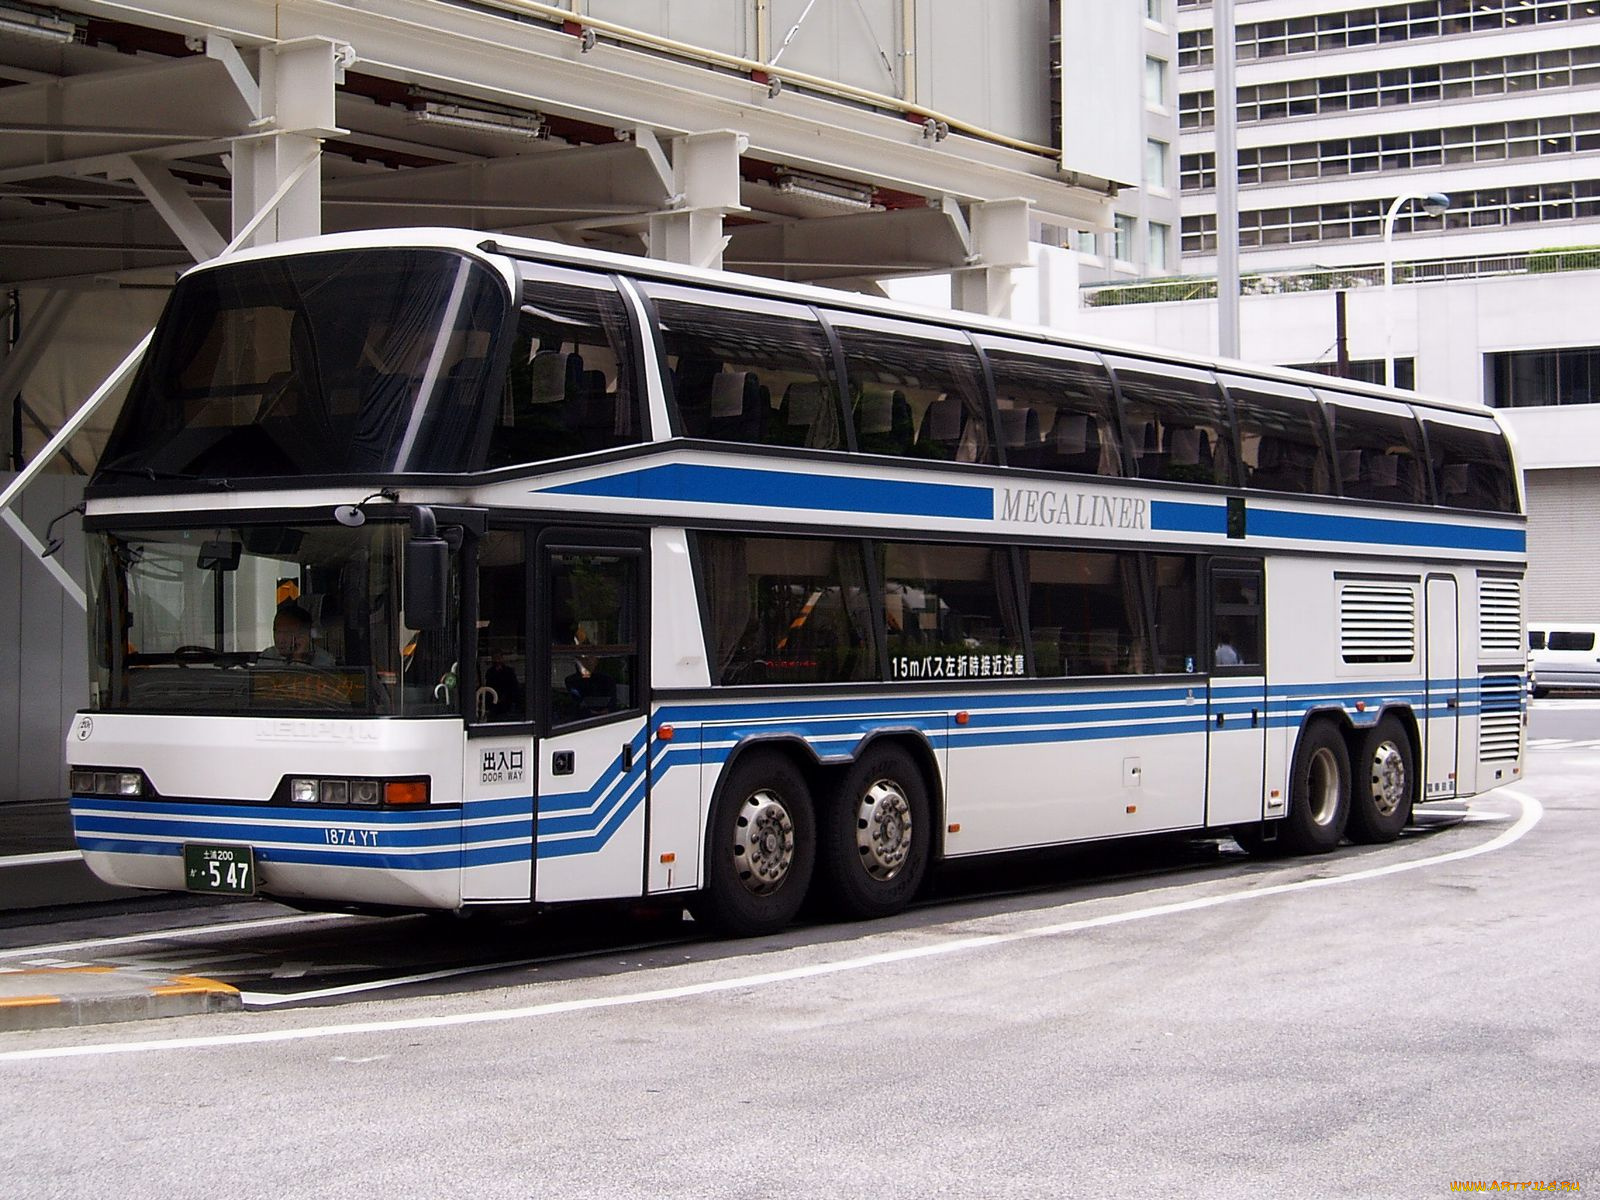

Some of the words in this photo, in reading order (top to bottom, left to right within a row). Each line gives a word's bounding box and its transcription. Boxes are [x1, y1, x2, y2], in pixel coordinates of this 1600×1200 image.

[1001, 488, 1146, 529] MEGALINER
[892, 655, 1025, 677] 15mバス左折時接近注意
[483, 751, 523, 771] 出入口
[483, 772, 503, 782] DOOR
[508, 771, 523, 781] WAY
[325, 829, 356, 845] 1874
[360, 830, 379, 846] YT
